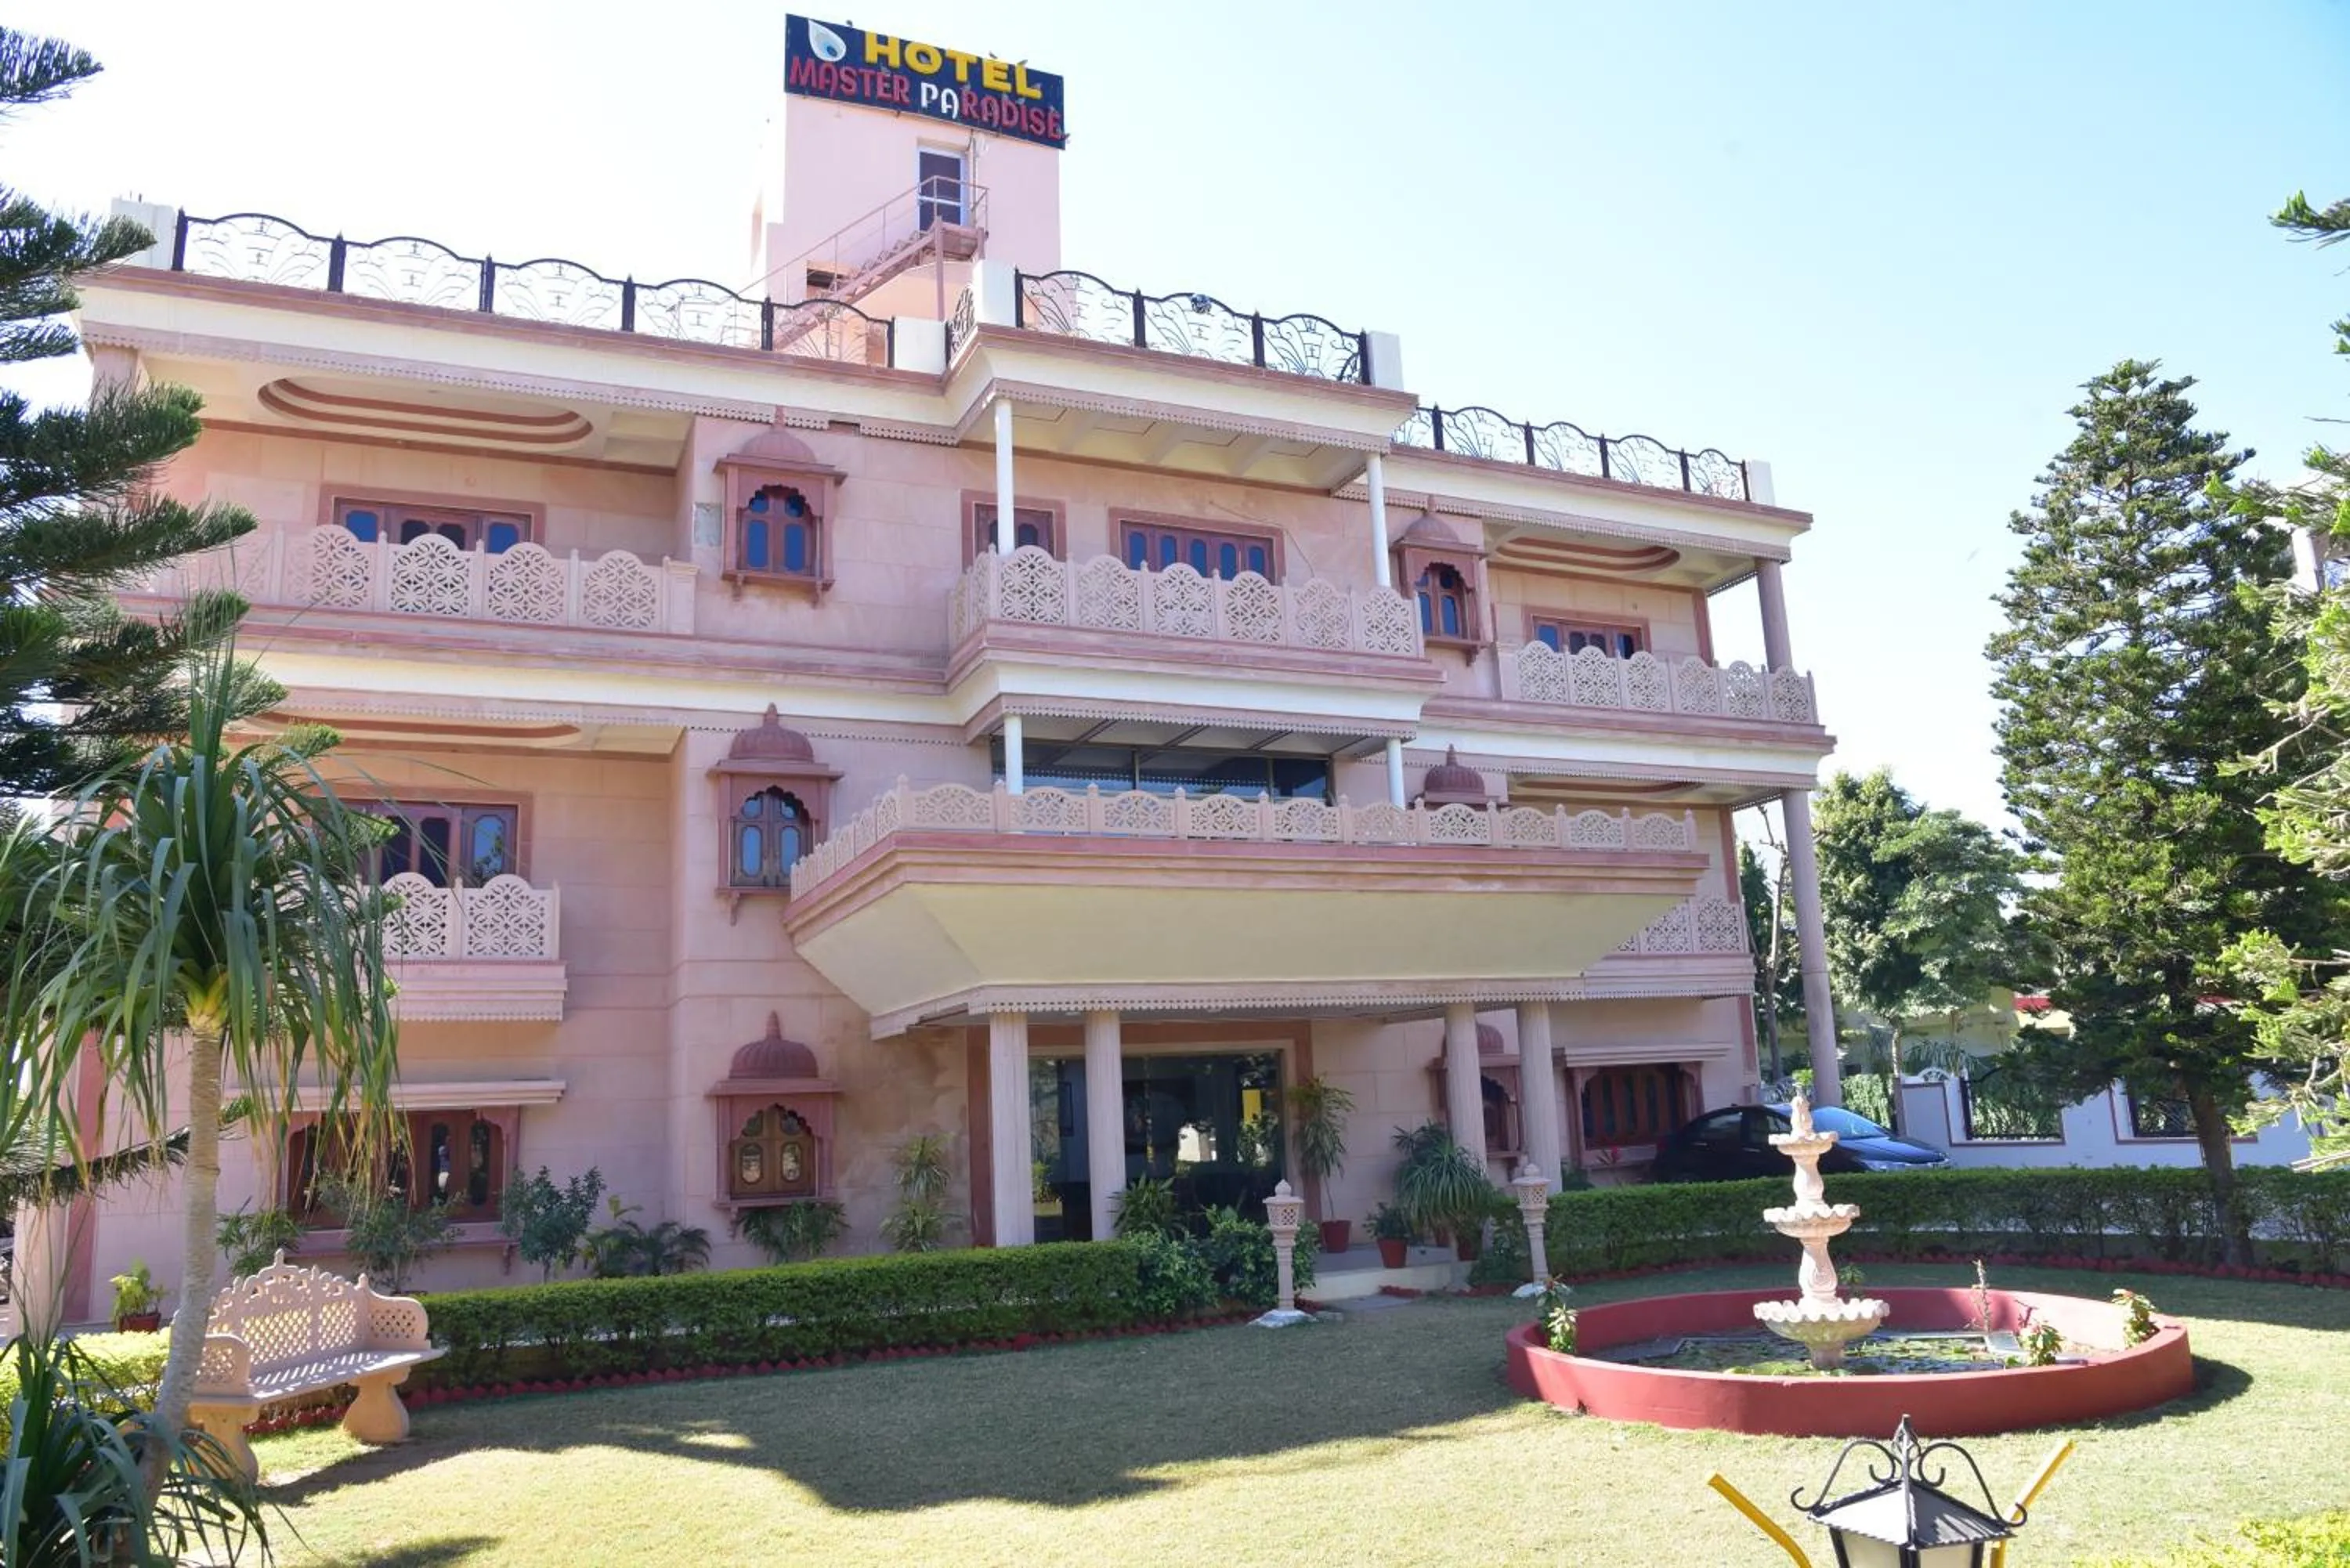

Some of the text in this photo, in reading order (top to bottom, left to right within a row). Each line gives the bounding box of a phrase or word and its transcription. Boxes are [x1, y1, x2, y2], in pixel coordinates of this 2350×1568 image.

[789, 56, 1062, 139] MASTER PARADISE
[865, 31, 1042, 99] HOTEL
